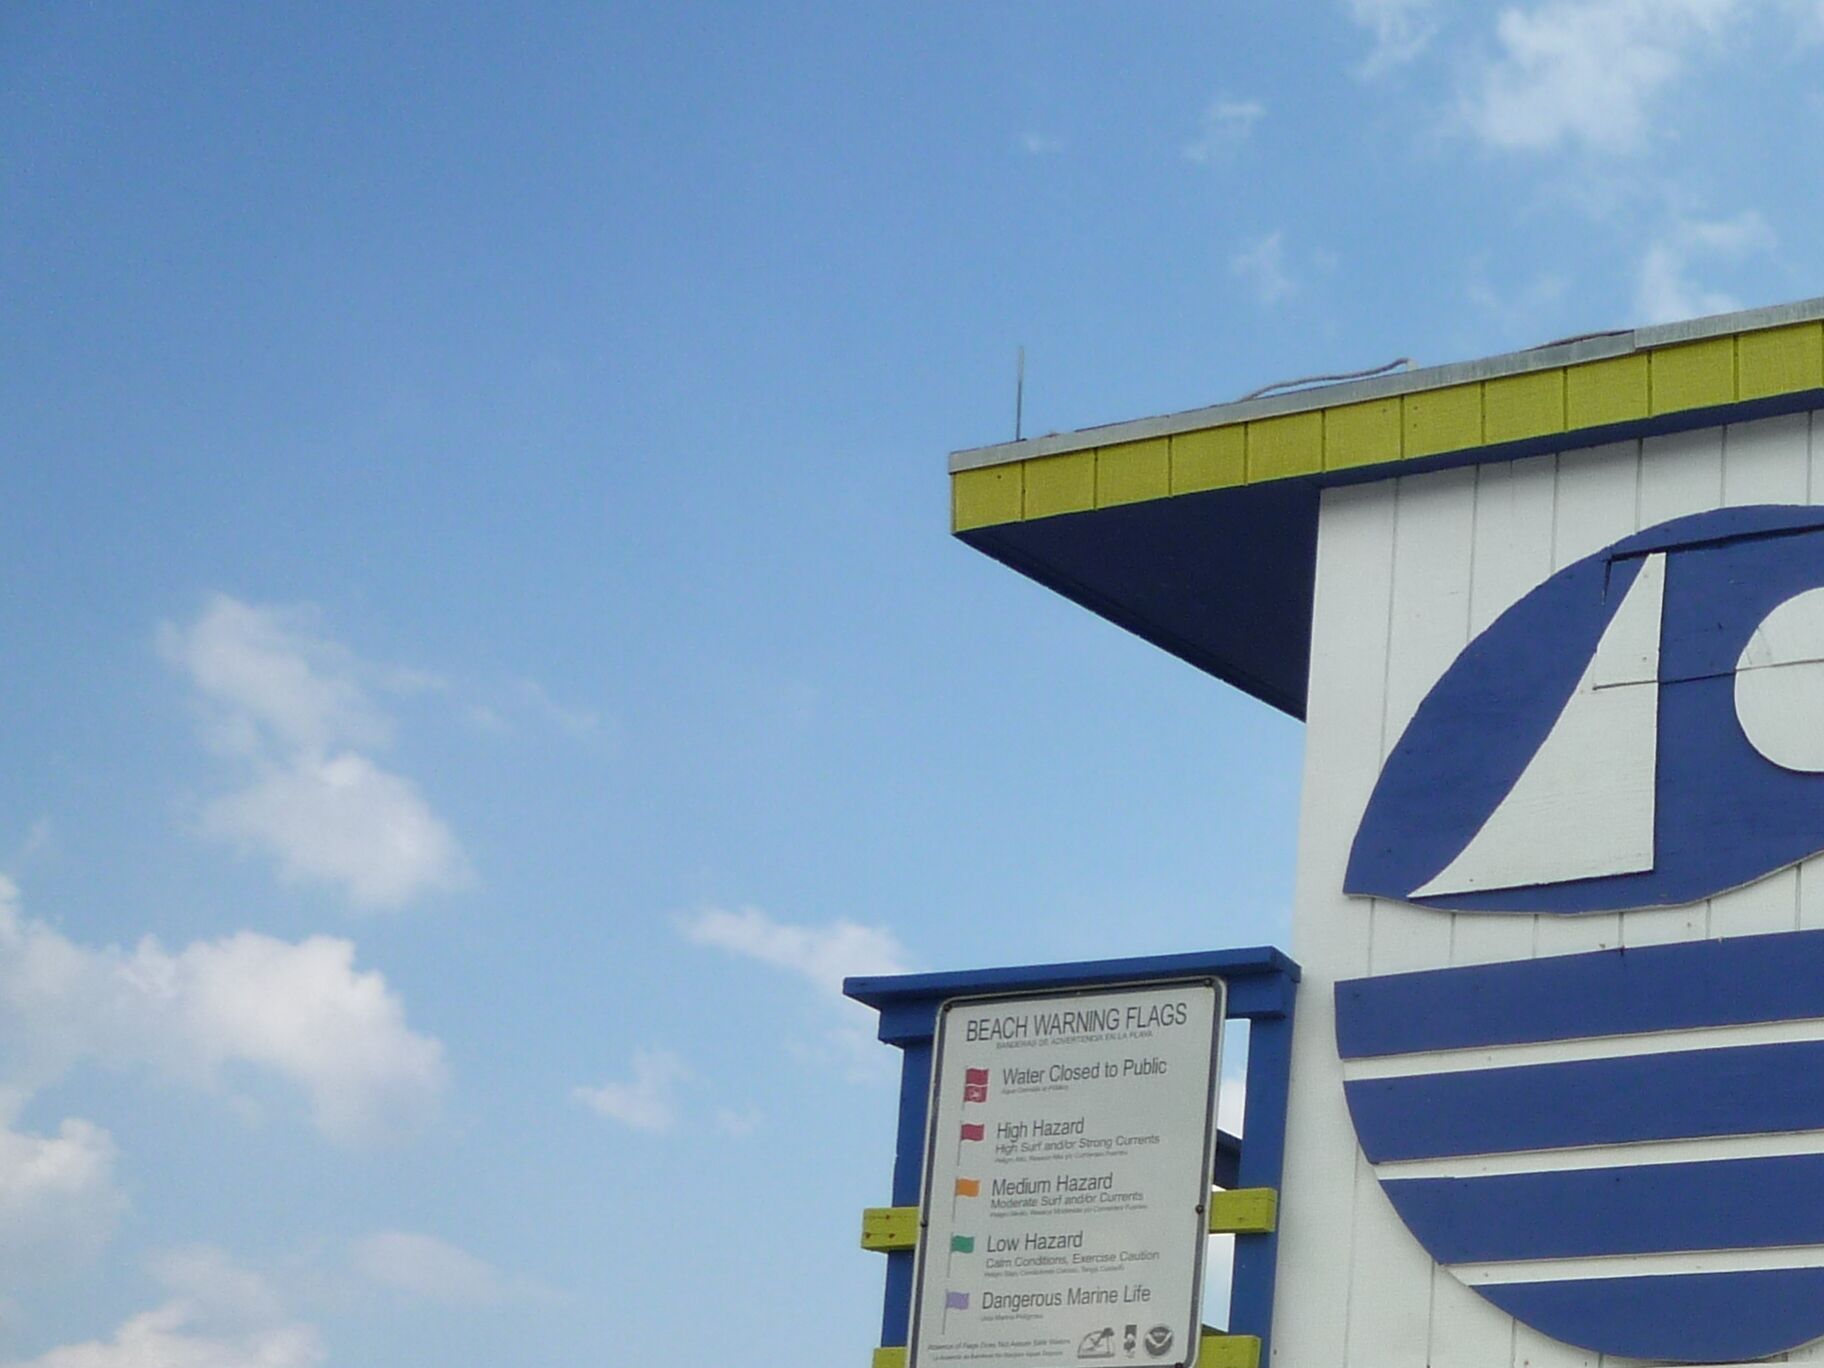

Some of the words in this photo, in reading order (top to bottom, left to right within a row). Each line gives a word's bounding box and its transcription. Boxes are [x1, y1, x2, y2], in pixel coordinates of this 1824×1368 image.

[966, 1015, 1028, 1042] BEACH
[1034, 1008, 1120, 1036] WARNING
[1126, 1002, 1188, 1029] FLAGS
[1002, 1068, 1045, 1085] Water
[1050, 1062, 1100, 1082] Closed
[1105, 1062, 1118, 1078] to
[1123, 1057, 1168, 1076] Public
[997, 1122, 1028, 1143] High
[1033, 1117, 1085, 1137] Hazard
[995, 1144, 1018, 1155] High
[1021, 1142, 1041, 1153] Surf
[1078, 1136, 1112, 1149] Strong
[1115, 1134, 1160, 1147] Currents
[992, 1177, 1051, 1196] Medium
[1056, 1172, 1114, 1192] Hazard
[990, 1198, 1037, 1209] Moderate
[1041, 1196, 1061, 1206] Surf
[1101, 1191, 1144, 1202] Currents
[987, 1235, 1020, 1252] Low
[1025, 1230, 1083, 1250] Hazard
[986, 1258, 1012, 1269] Calm
[1072, 1253, 1116, 1264] Exercise
[1120, 1250, 1160, 1262] Caution
[982, 1291, 1062, 1312] Dangerous
[1067, 1287, 1118, 1306] Marine
[1123, 1284, 1151, 1303] Life
